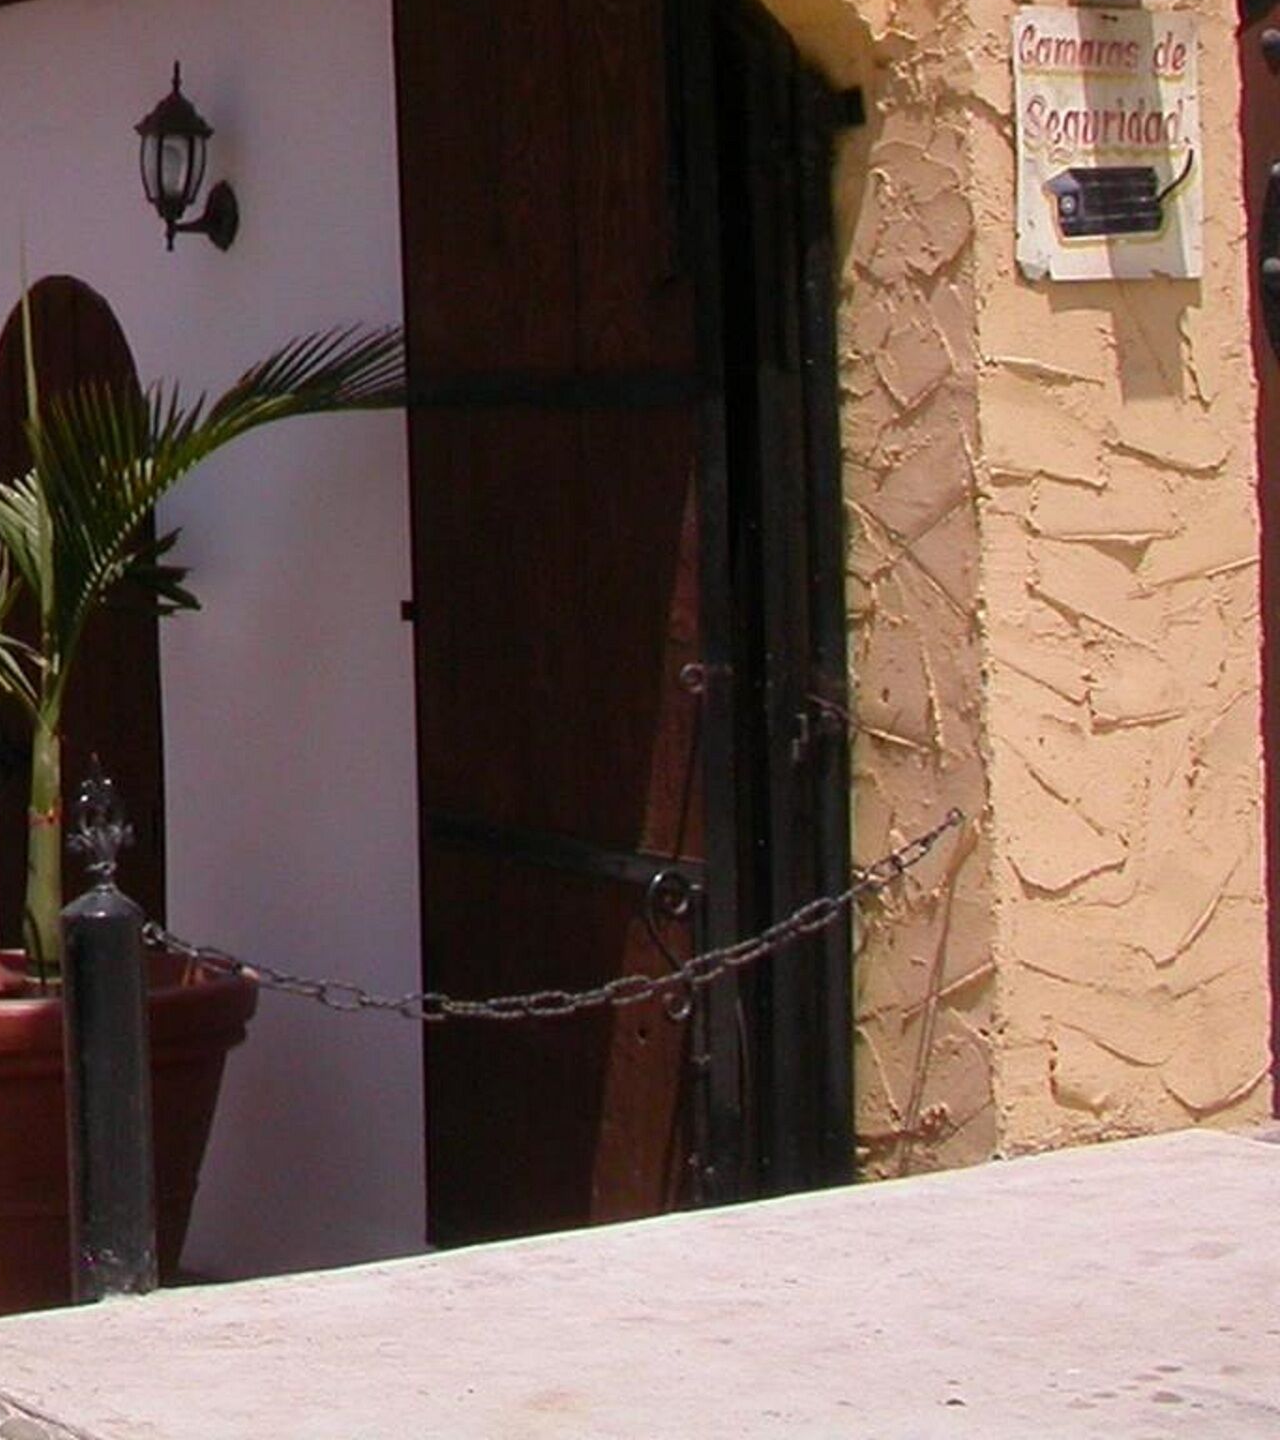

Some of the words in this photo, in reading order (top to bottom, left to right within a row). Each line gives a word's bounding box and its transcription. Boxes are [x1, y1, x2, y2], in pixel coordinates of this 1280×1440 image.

[1019, 24, 1140, 68] Camaras
[1153, 31, 1187, 71] de
[1026, 95, 1184, 159] Seguridad
